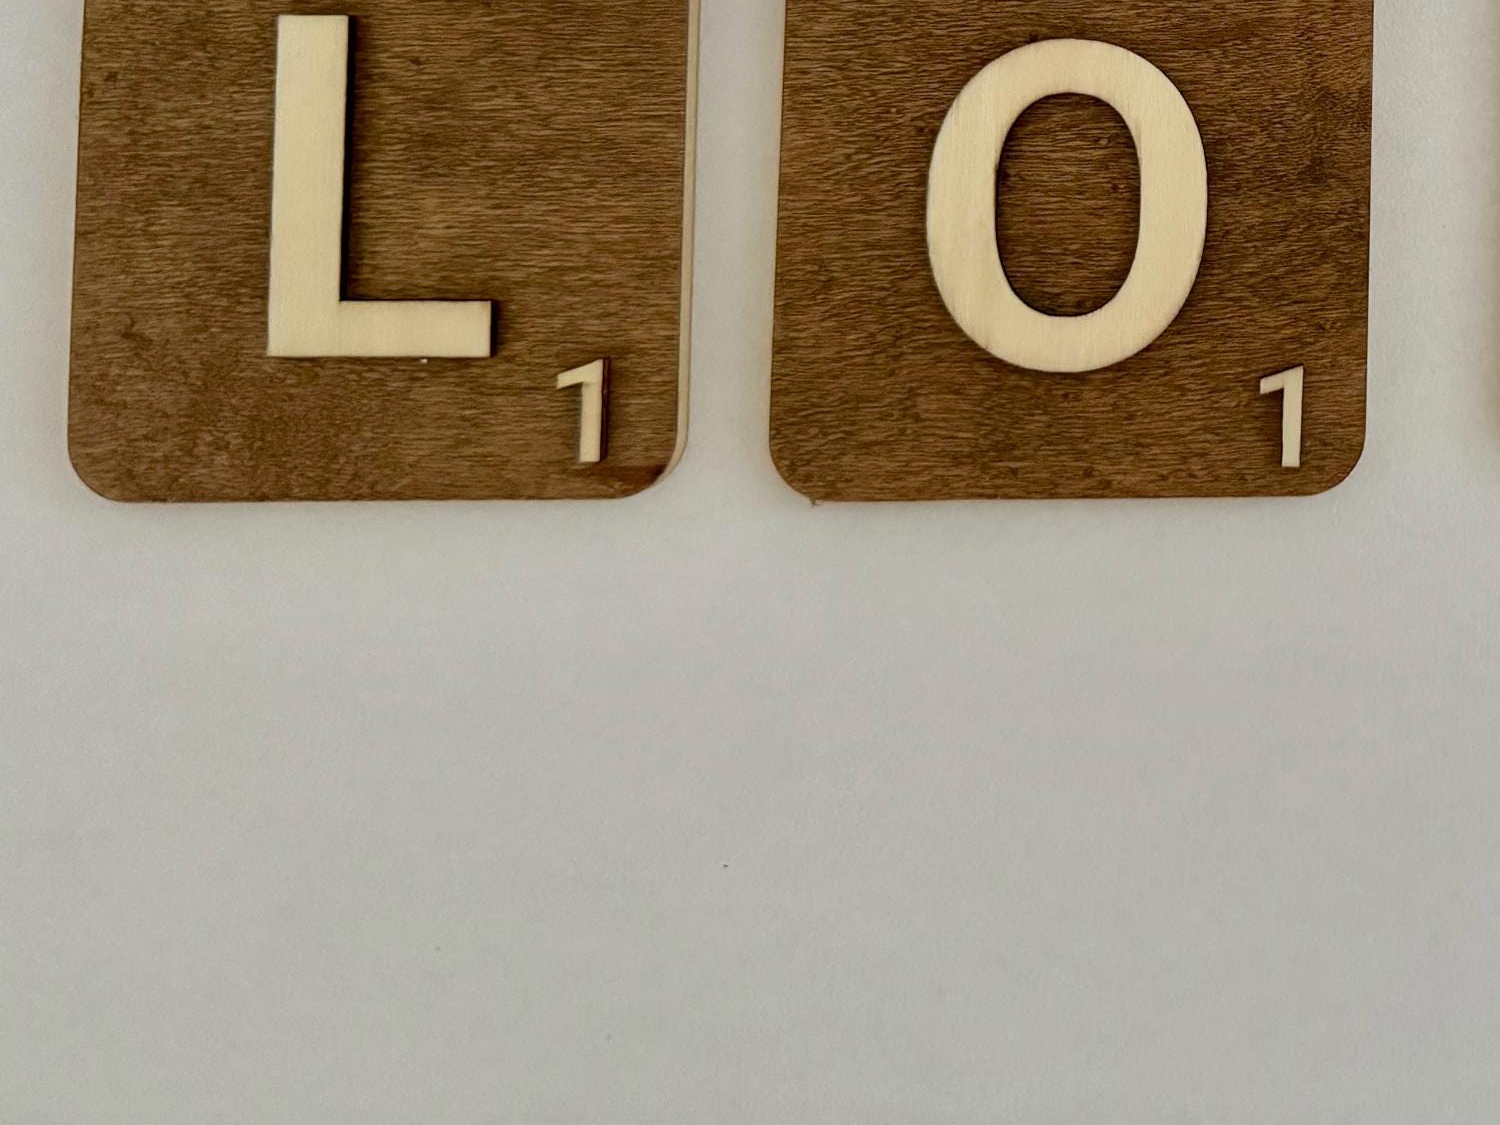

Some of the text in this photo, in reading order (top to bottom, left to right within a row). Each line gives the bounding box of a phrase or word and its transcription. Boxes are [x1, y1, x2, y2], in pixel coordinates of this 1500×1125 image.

[267, 14, 490, 357] L
[926, 39, 1207, 372] O
[555, 359, 605, 464] 1
[1259, 365, 1304, 468] 1
